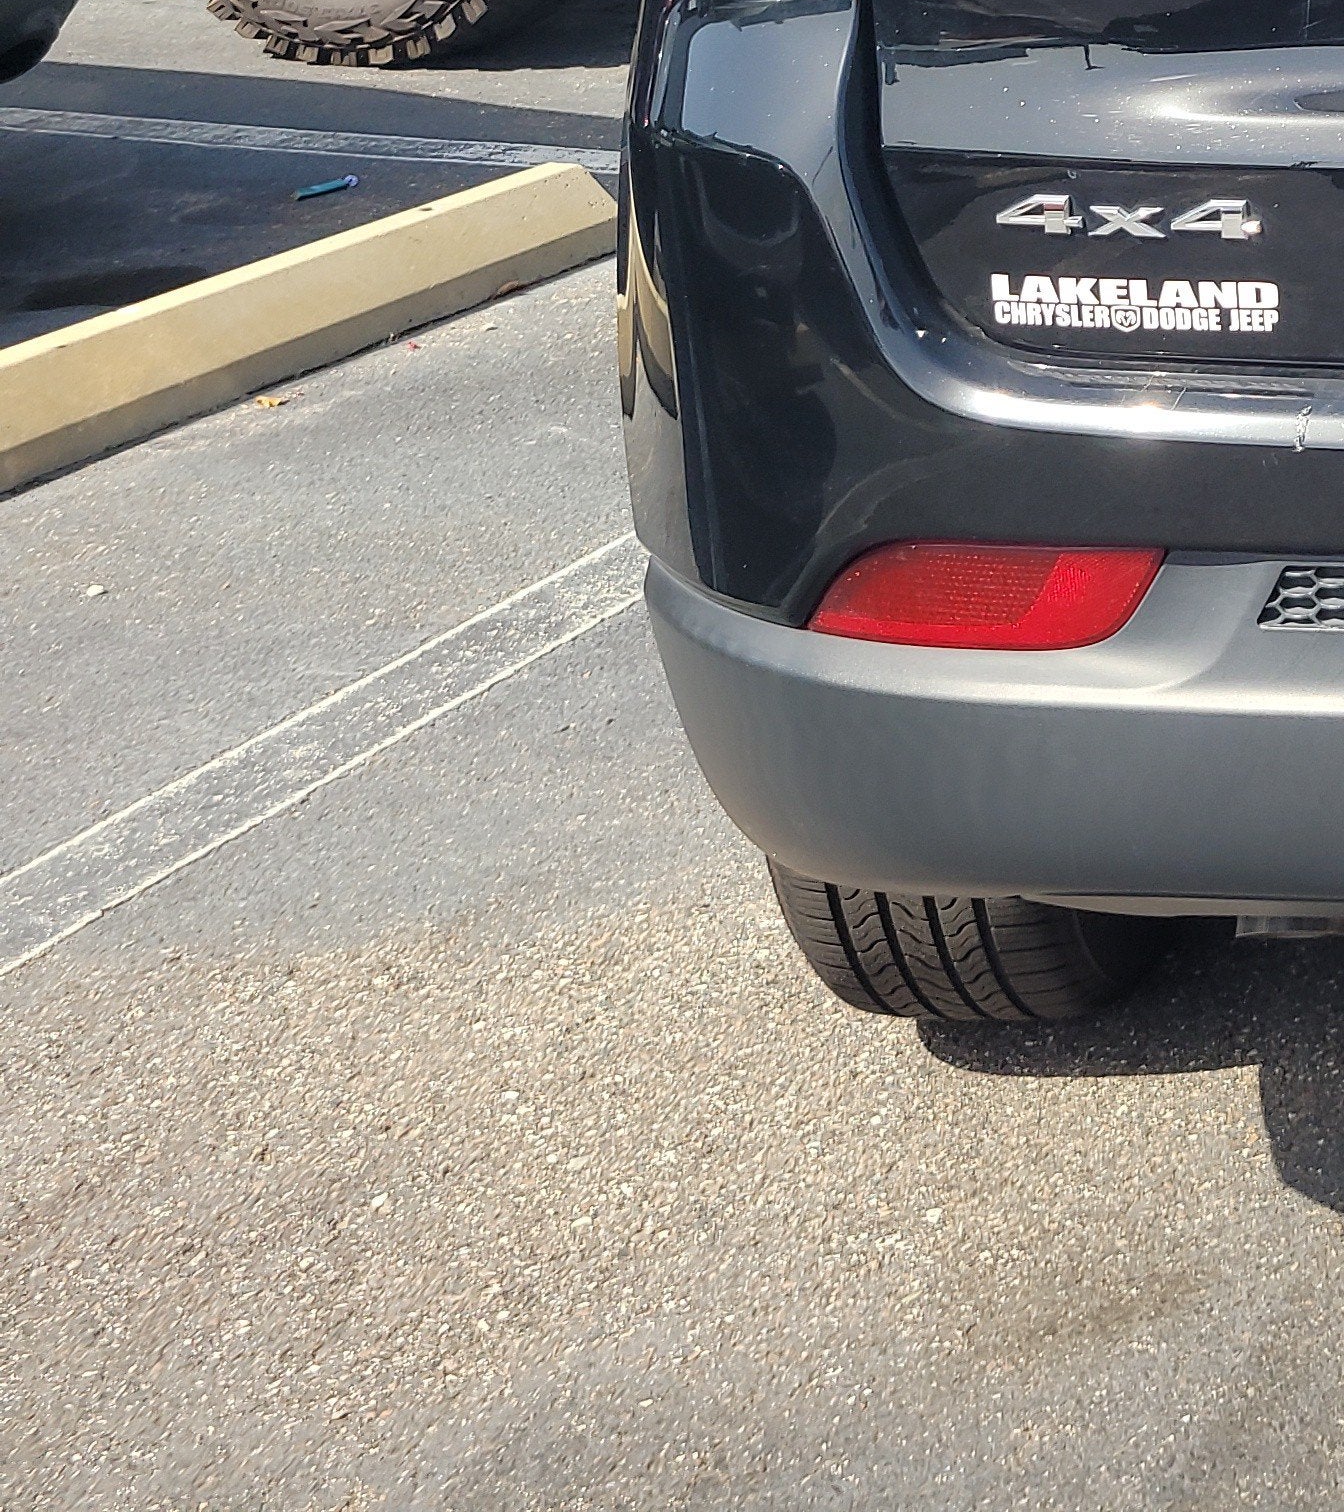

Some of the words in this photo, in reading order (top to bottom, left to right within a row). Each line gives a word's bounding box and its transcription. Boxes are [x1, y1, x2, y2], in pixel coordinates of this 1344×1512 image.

[995, 194, 1263, 239] 4x4
[990, 273, 1280, 309] LAKELAND
[994, 301, 1111, 328] CHRYSLER
[1143, 306, 1222, 331] DODGE
[1229, 309, 1279, 332] JEEP
